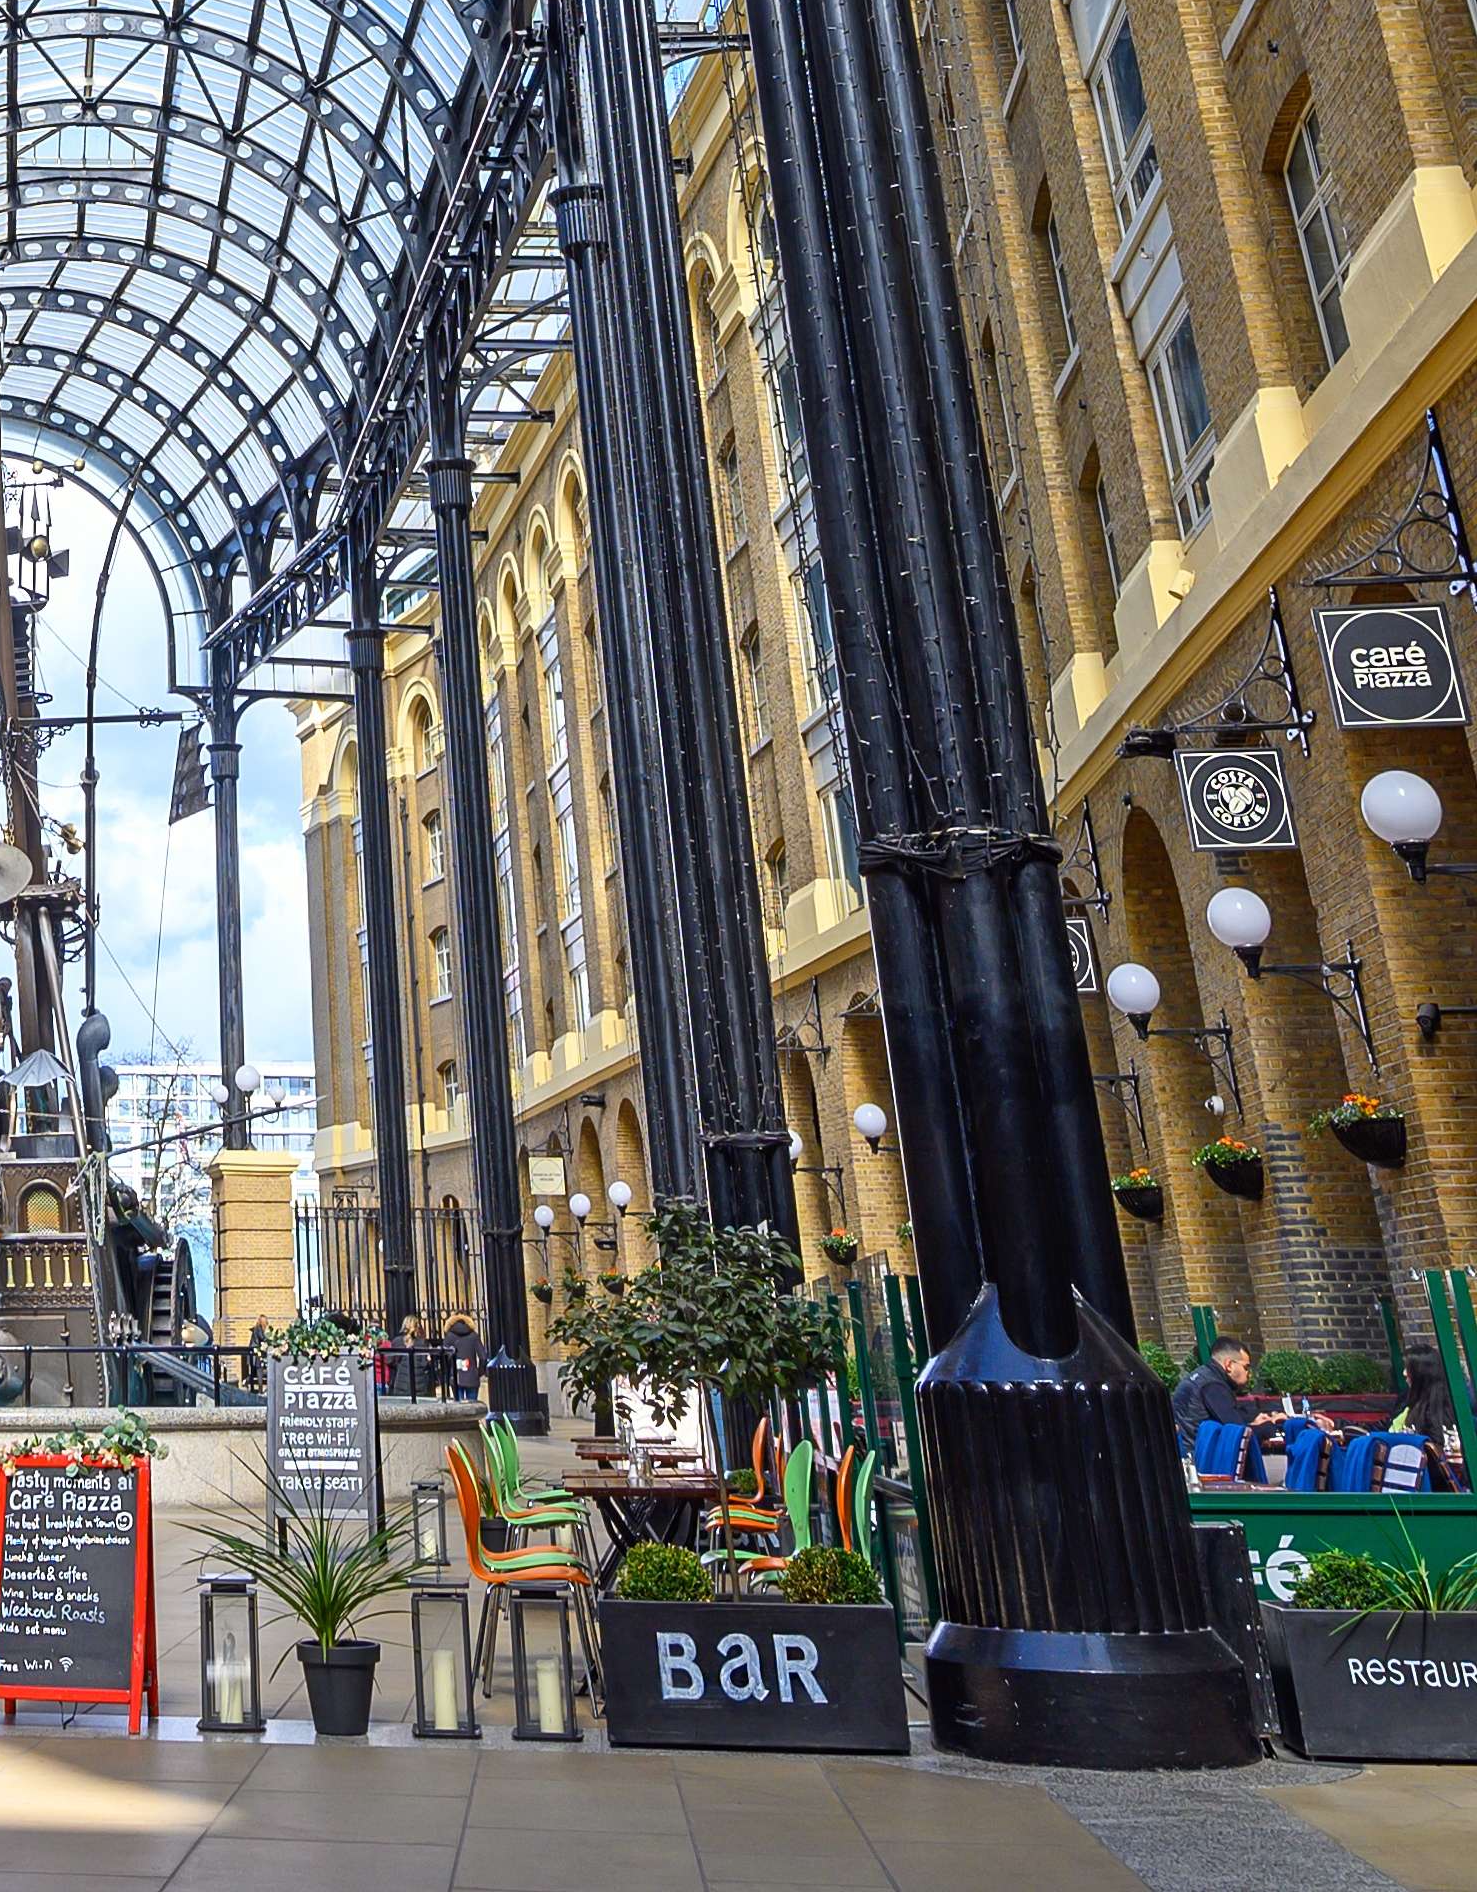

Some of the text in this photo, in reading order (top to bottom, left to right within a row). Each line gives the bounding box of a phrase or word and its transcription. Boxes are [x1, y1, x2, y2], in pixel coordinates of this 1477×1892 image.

[1211, 770, 1255, 790] COSTA
[1213, 804, 1266, 827] COFFEE
[11, 1470, 49, 1495] Tasty
[54, 1470, 111, 1490] moments
[62, 1491, 122, 1511] Piazza
[5, 1513, 20, 1529] The
[21, 1513, 40, 1529] best
[45, 1513, 83, 1532] breakfast
[93, 1515, 115, 1529] town
[4, 1551, 26, 1562] Lunch
[38, 1551, 66, 1562] dinner
[3, 1566, 88, 1584] Desserts & coffee
[32, 1586, 54, 1600] beer
[55, 1587, 64, 1601] &
[67, 1586, 99, 1603] snacks
[1, 1600, 106, 1624] Weekend Roasts
[0, 1621, 66, 1635] Kids set menu
